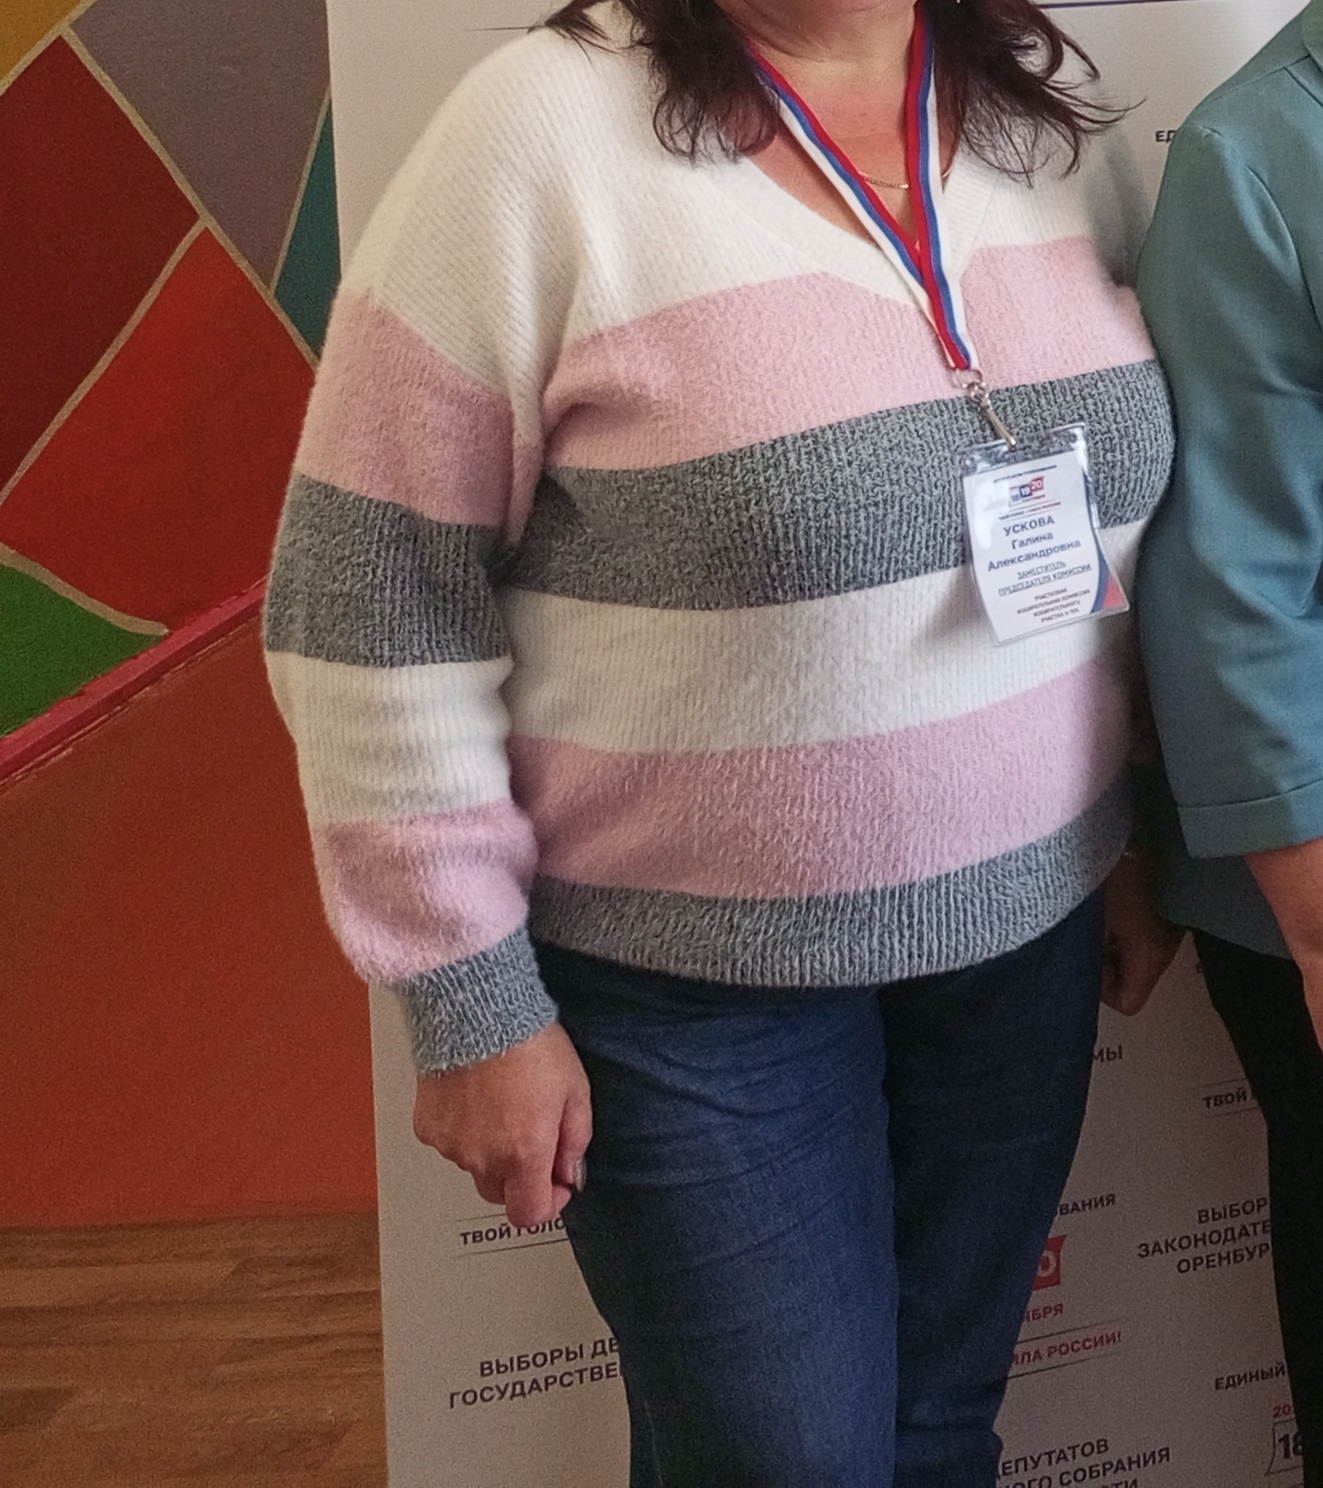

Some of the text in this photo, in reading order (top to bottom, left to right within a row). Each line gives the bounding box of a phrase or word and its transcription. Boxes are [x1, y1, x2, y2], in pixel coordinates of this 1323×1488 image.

[1003, 515, 1055, 537] УСКОВА
[1011, 532, 1054, 550] Галина
[987, 540, 1082, 572] Александровна
[1202, 1086, 1248, 1109] ТВОЙ
[1197, 1197, 1268, 1225] ВЫБОР
[459, 1217, 512, 1246] ТВОЙ
[1138, 1218, 1274, 1259] ЗАКОНОДАТЕ
[1177, 1242, 1270, 1274] ОРЕНБУР
[1047, 1330, 1122, 1358] РОССИИ!
[479, 1343, 584, 1378] ВЫБОРЫ
[1214, 1361, 1286, 1391] ЕДИНЫЙ
[449, 1361, 623, 1409] ГОСУДАРСТВЕ
[999, 1438, 1109, 1477] ЕПУТАТОВ
[1058, 1446, 1170, 1487] СОБРАНИЯ
